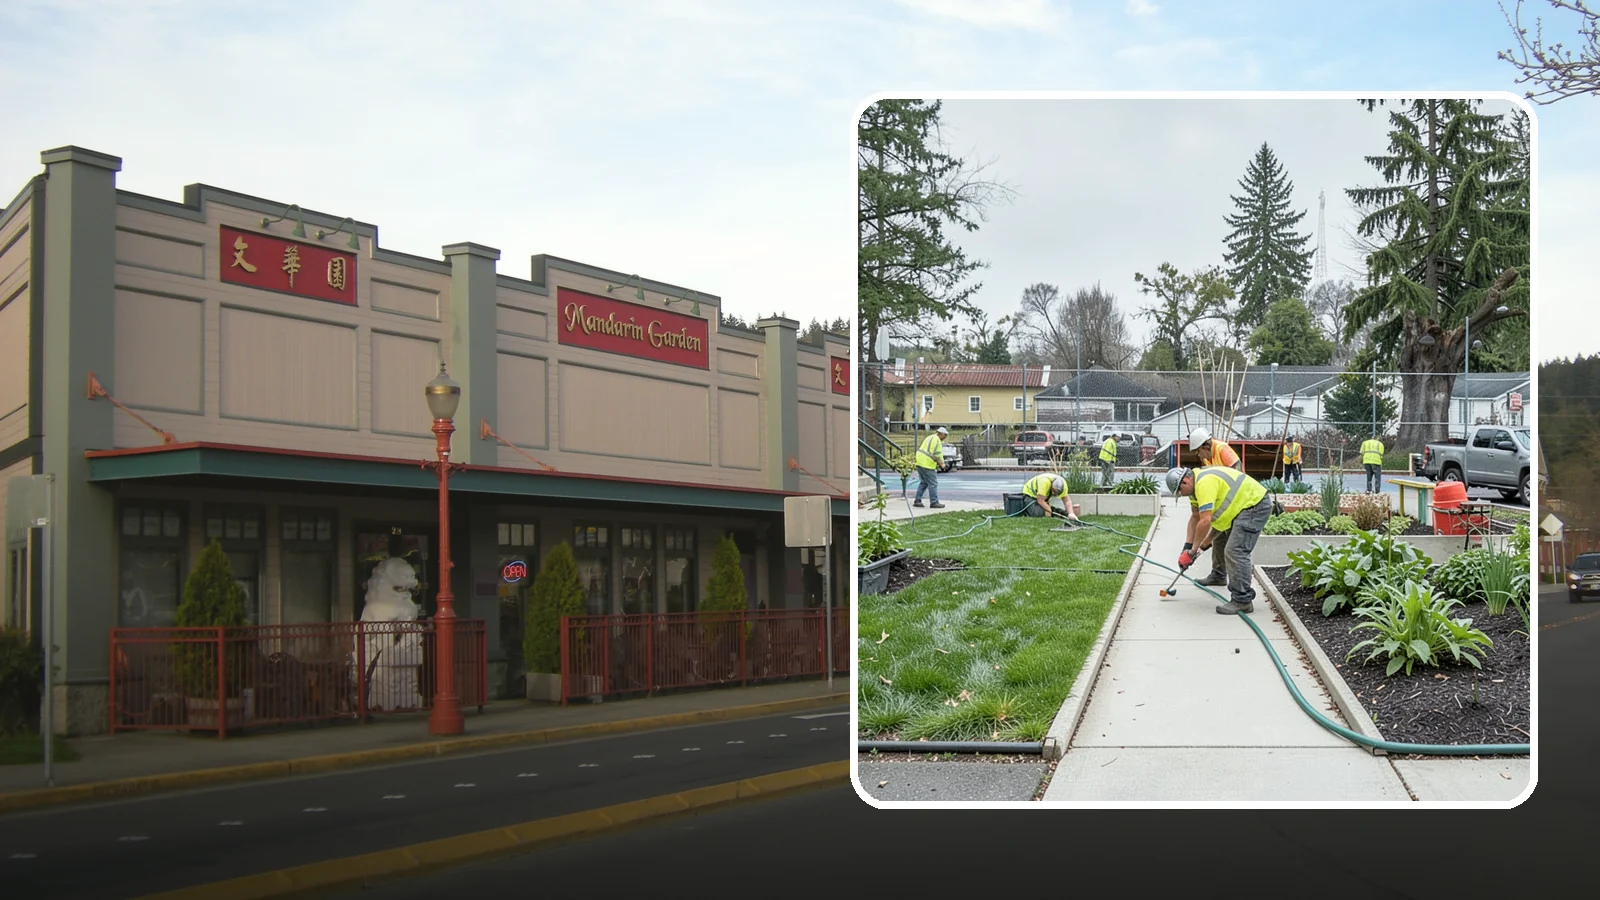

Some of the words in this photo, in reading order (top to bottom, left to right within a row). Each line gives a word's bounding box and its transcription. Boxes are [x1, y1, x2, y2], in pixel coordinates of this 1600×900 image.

[230, 235, 346, 291] 文華園
[564, 302, 644, 341] Mandarin
[648, 320, 702, 352] Garden
[503, 565, 527, 578] OPEN
